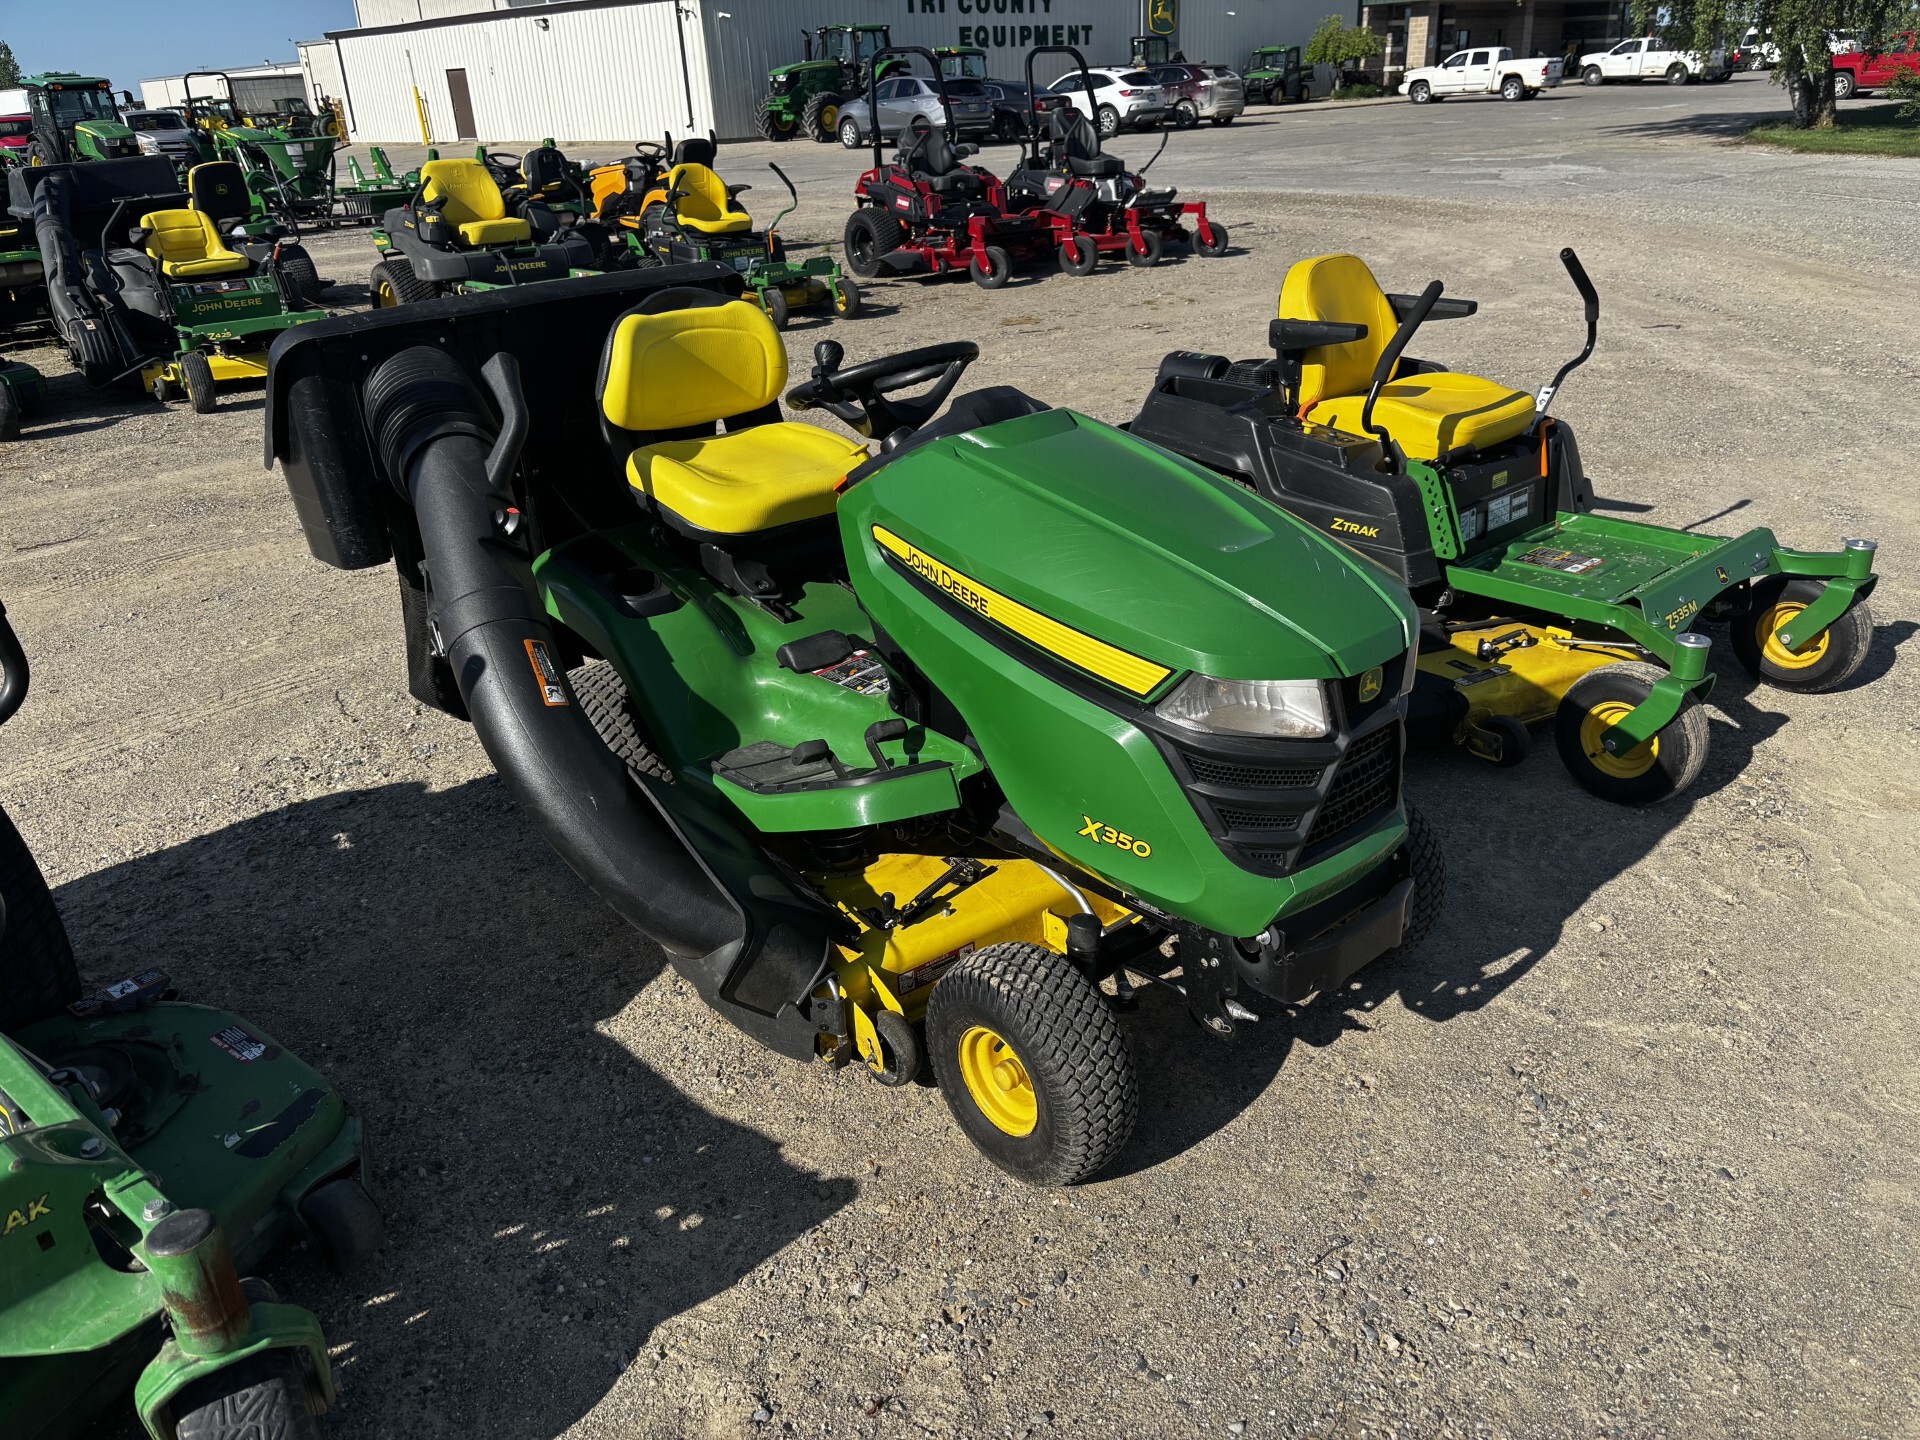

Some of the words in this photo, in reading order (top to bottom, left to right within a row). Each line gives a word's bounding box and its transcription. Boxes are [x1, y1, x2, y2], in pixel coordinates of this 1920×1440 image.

[907, 0, 946, 14] TRI
[957, 0, 1052, 14] COUNTY
[958, 25, 1093, 48] EQUIPMENT
[721, 250, 741, 259] JOHN
[741, 247, 765, 256] DEERE
[519, 261, 547, 270] DEERE
[192, 302, 222, 313] JOHN
[224, 298, 263, 309] DEERE
[207, 331, 232, 341] Z425
[1330, 517, 1380, 538] ZTRAK
[904, 546, 940, 588] JOHN
[942, 571, 990, 617] DEERE
[1665, 600, 1698, 630] Z535M
[1076, 812, 1153, 859] X350
